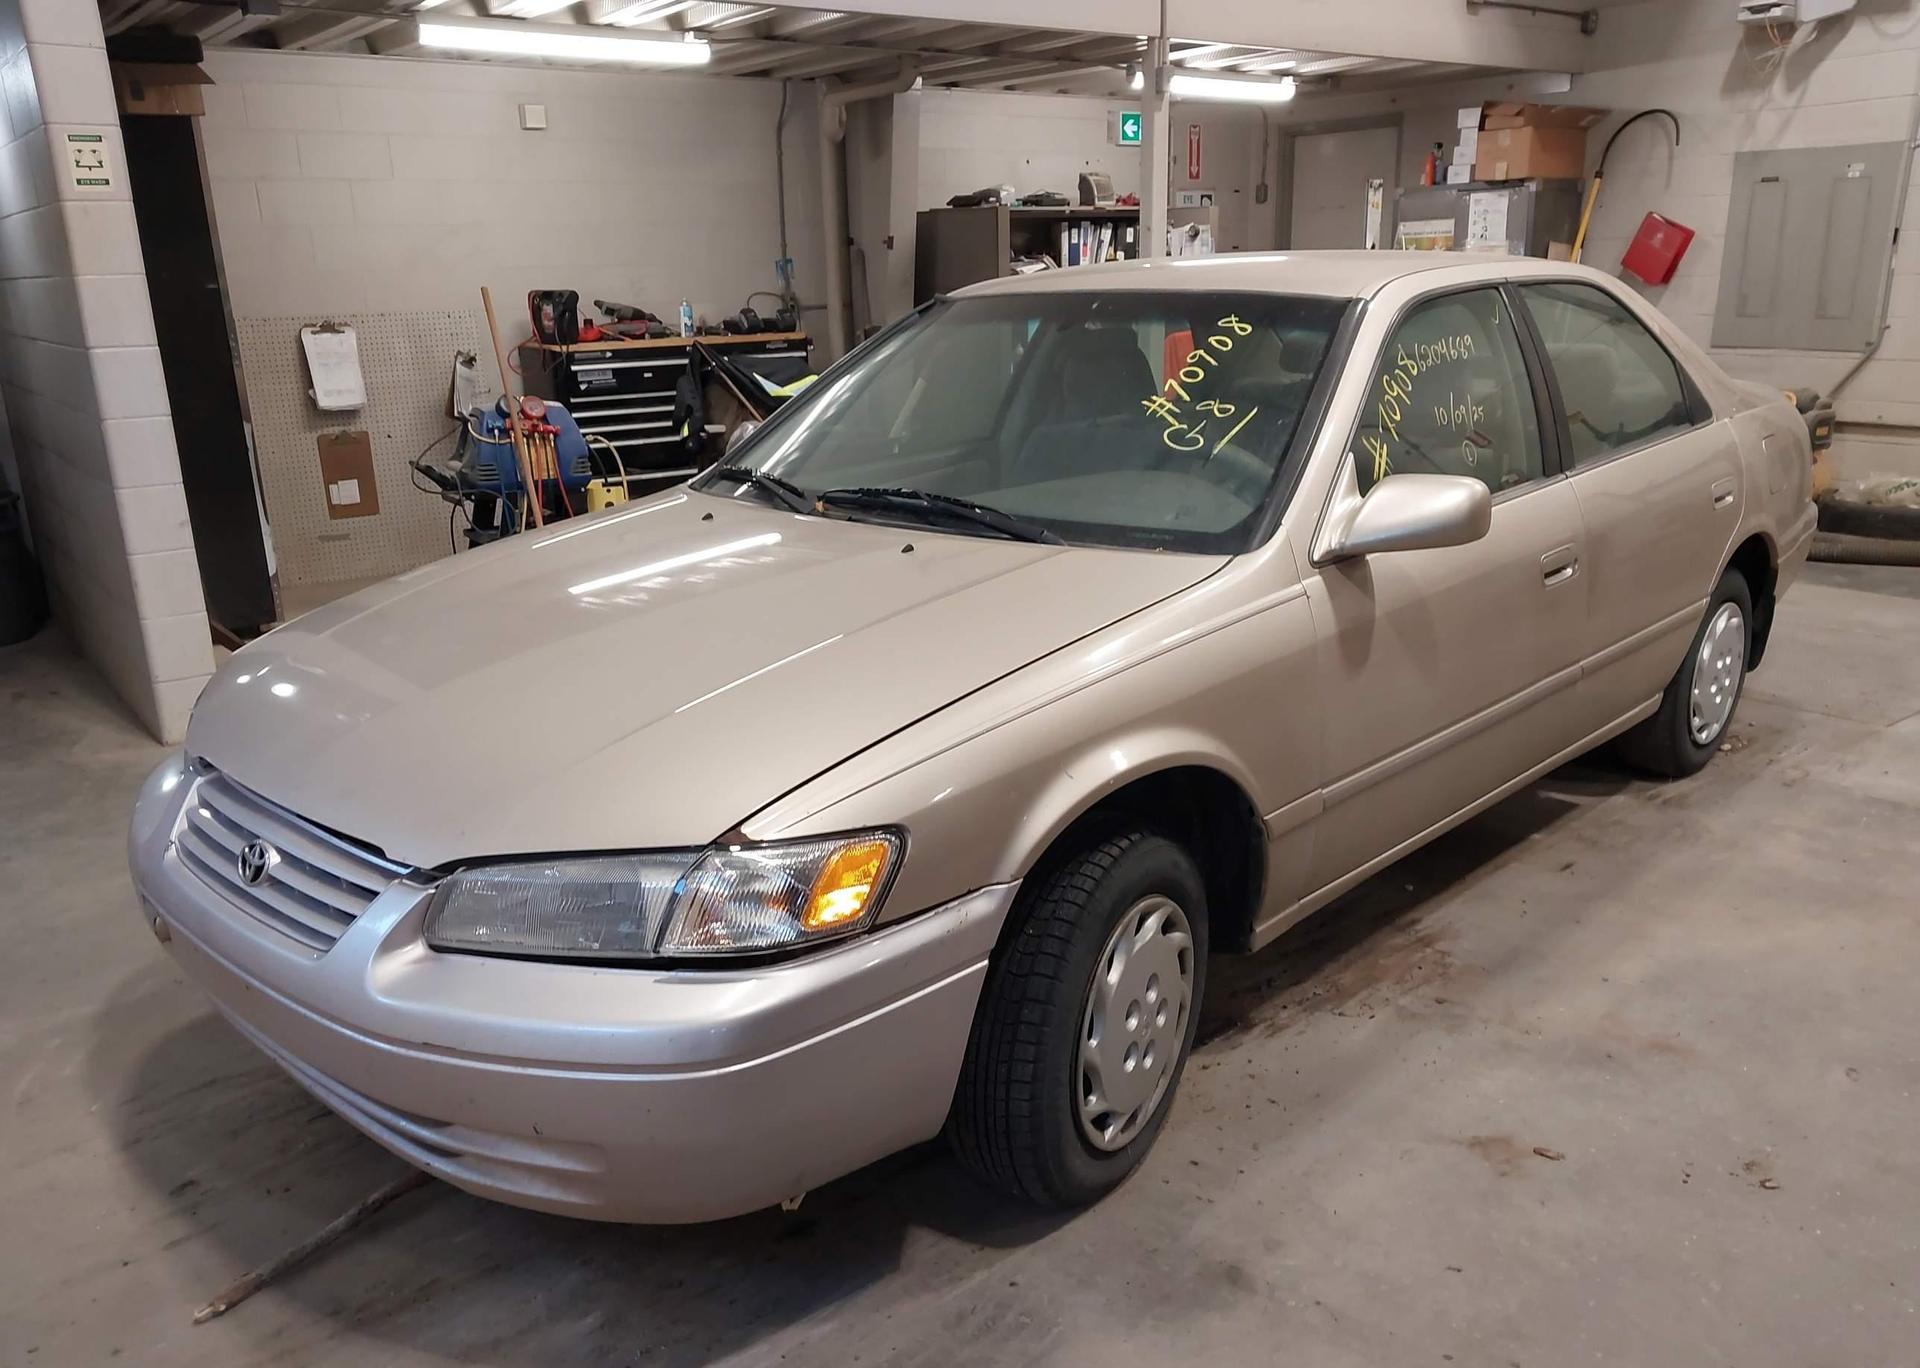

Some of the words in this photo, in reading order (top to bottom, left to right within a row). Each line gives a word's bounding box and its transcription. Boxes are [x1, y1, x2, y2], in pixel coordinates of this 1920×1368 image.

[1183, 194, 1193, 204] EYE
[1141, 314, 1252, 426] #70908
[1434, 391, 1485, 432] 10/09/25
